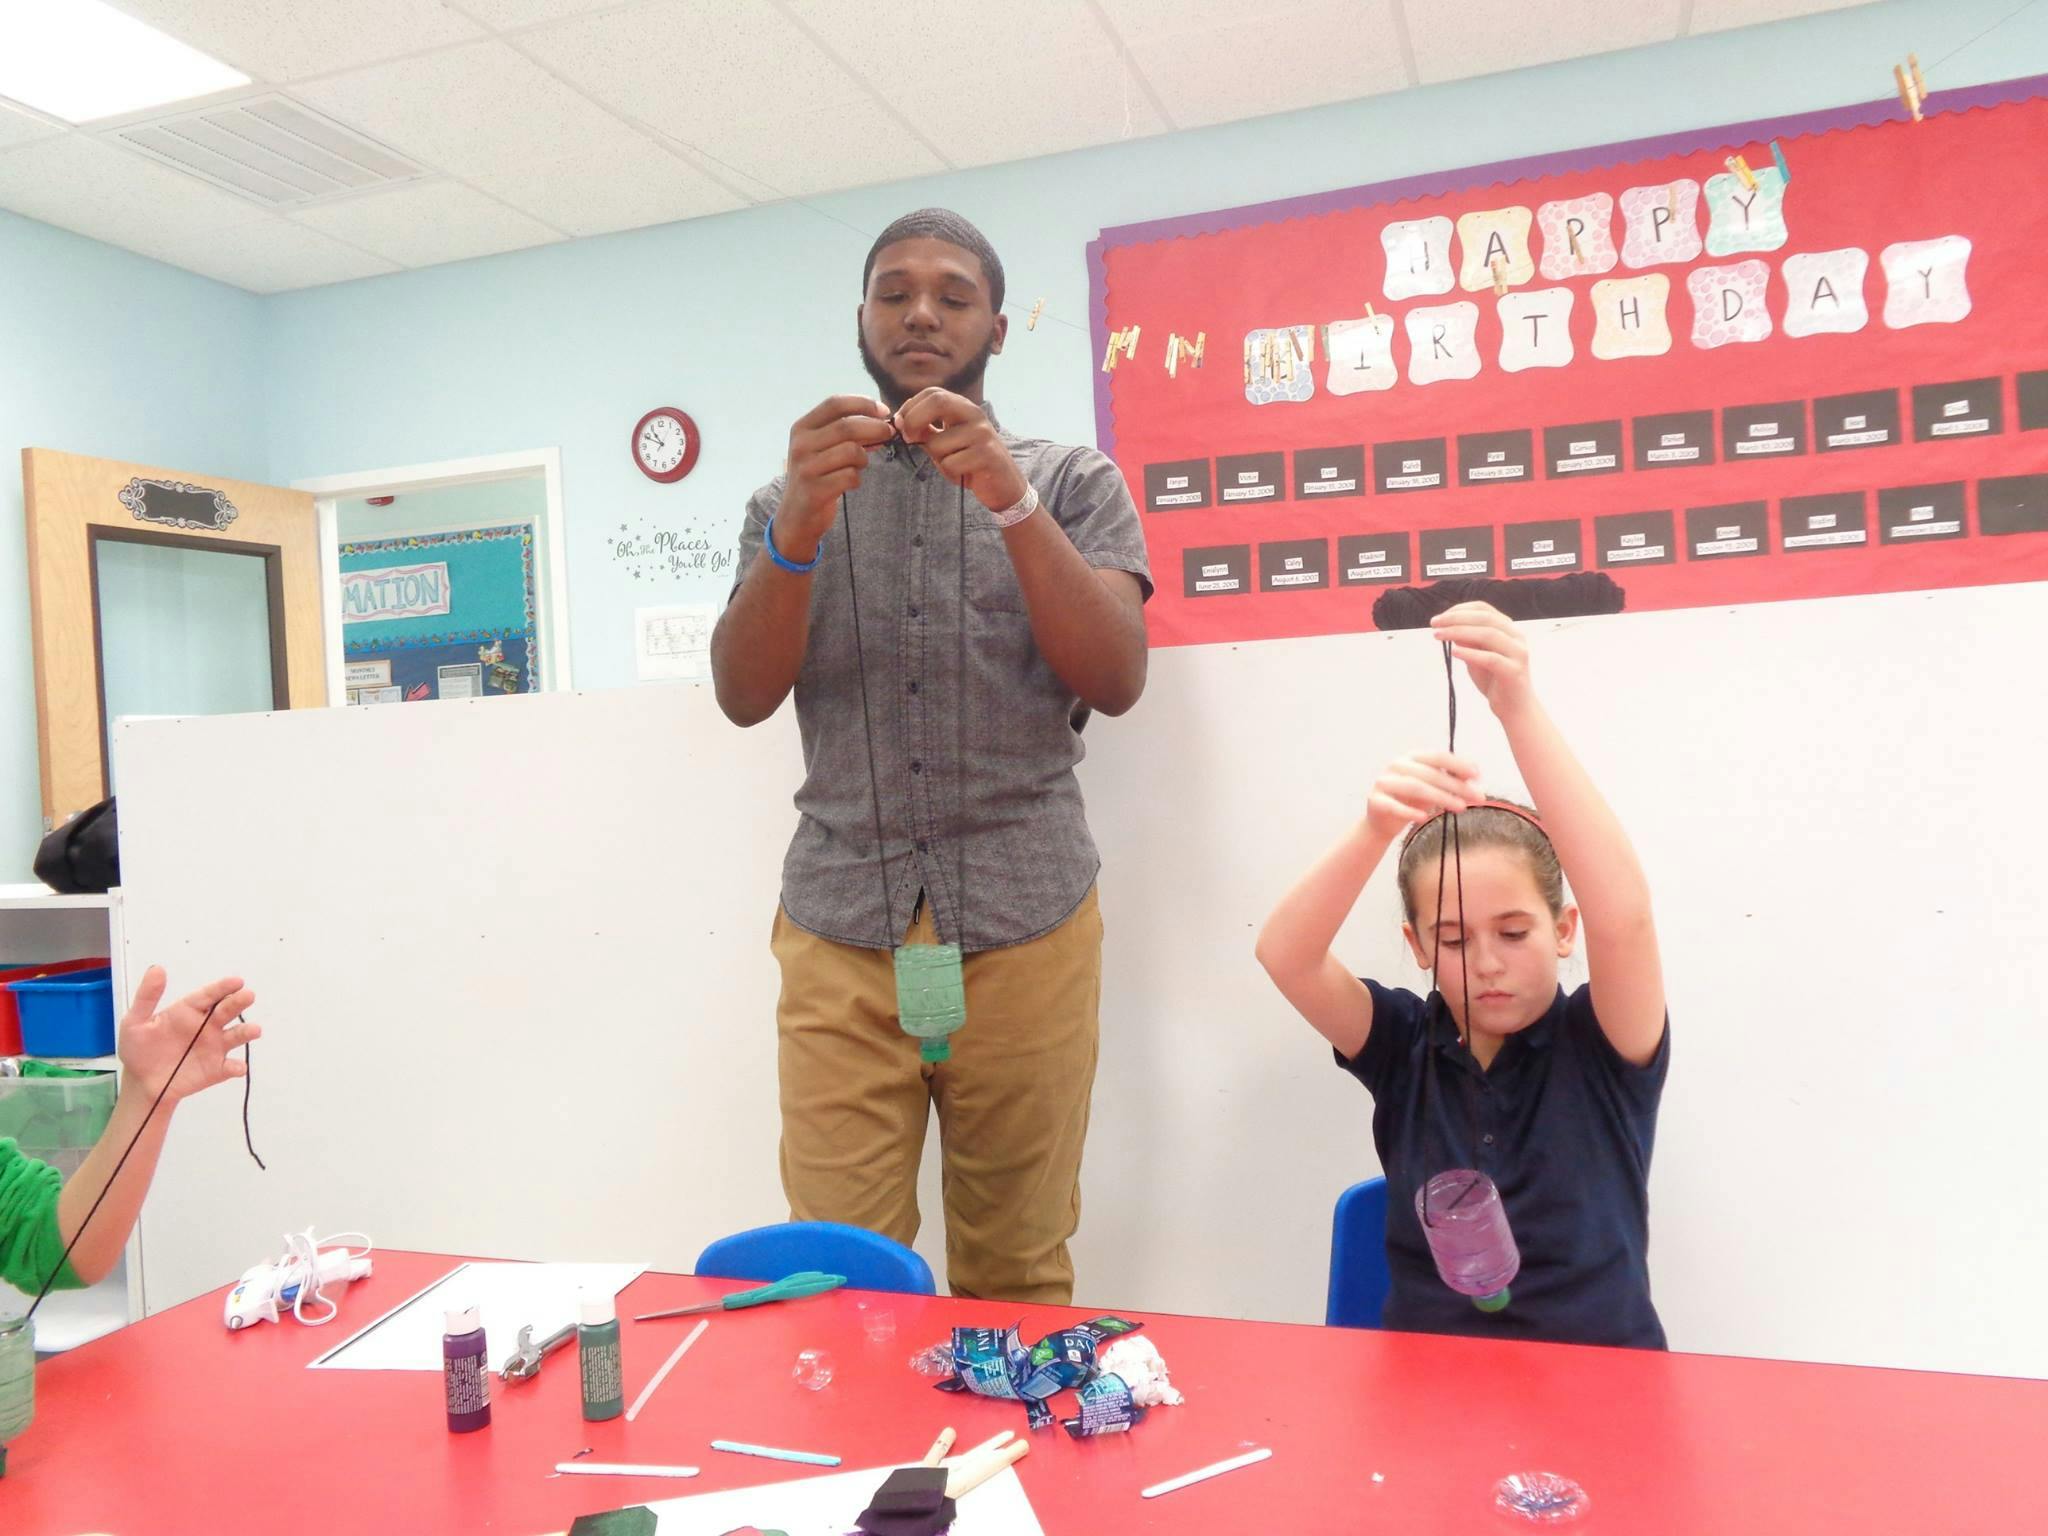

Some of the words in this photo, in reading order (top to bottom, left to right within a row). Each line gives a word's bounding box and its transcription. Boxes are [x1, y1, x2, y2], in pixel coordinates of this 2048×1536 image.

[1268, 266, 1937, 380] IRTHDAY
[657, 420, 665, 428] 12
[616, 540, 641, 559] Oh,
[639, 543, 656, 556] The
[654, 531, 712, 555] Places
[667, 552, 707, 574] You'll
[711, 548, 733, 573] Go!
[342, 570, 440, 614] MATION
